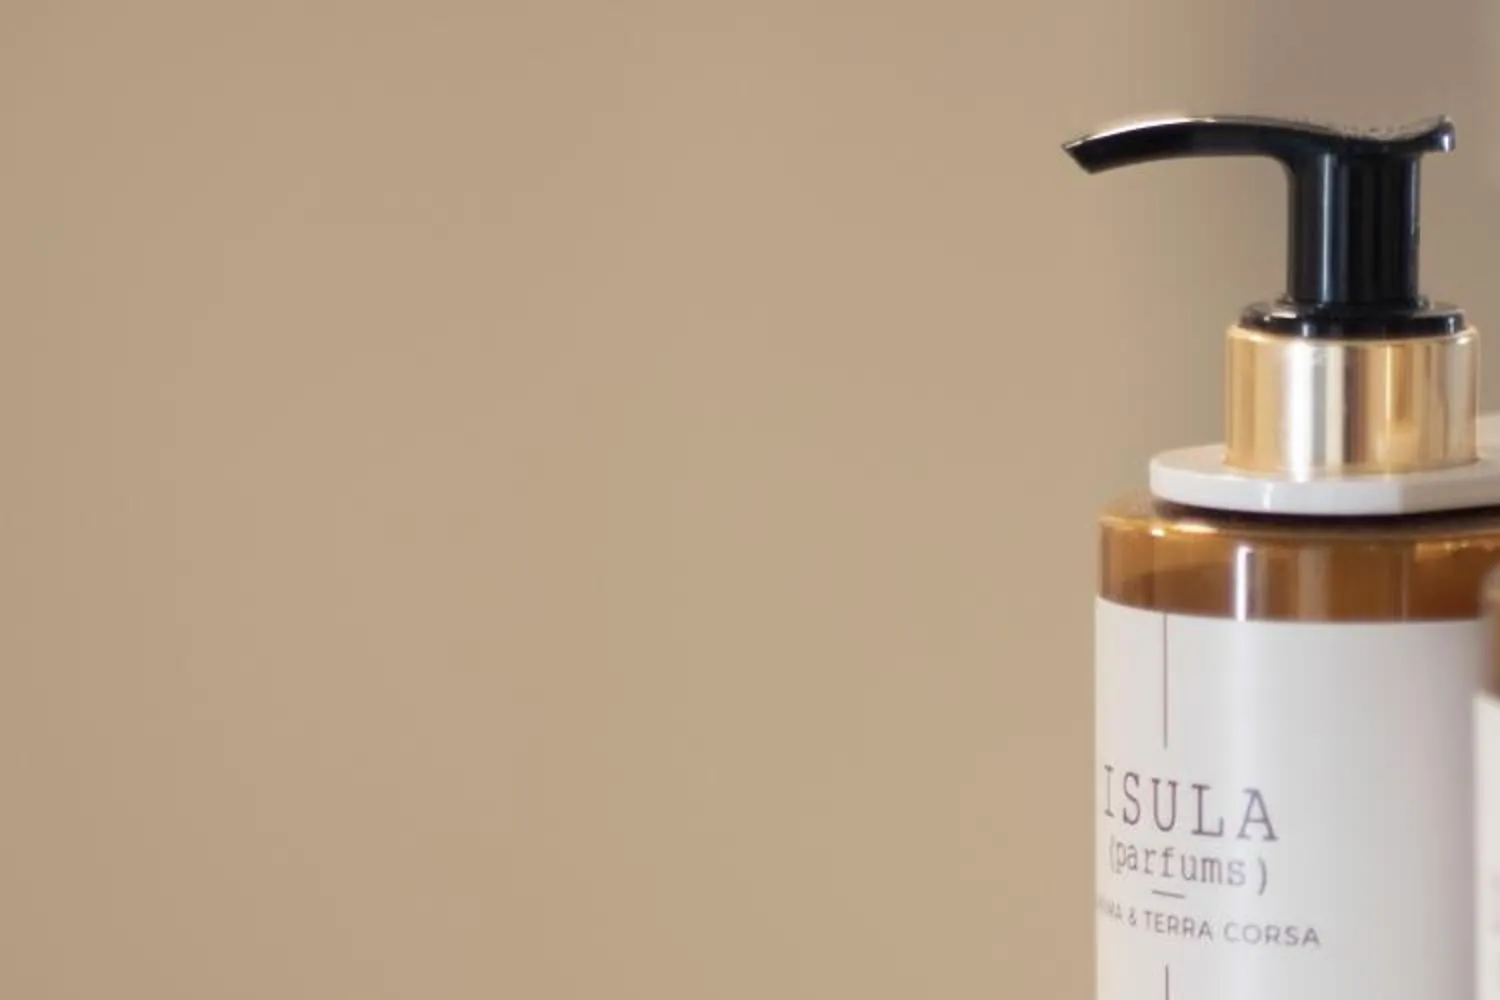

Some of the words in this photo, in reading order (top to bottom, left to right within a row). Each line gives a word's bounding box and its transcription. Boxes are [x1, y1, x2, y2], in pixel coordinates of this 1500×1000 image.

[1103, 764, 1279, 842] ISULA
[1109, 834, 1267, 896] (parfums)
[1143, 909, 1213, 941] TERRA
[1223, 921, 1320, 947] CORSA
